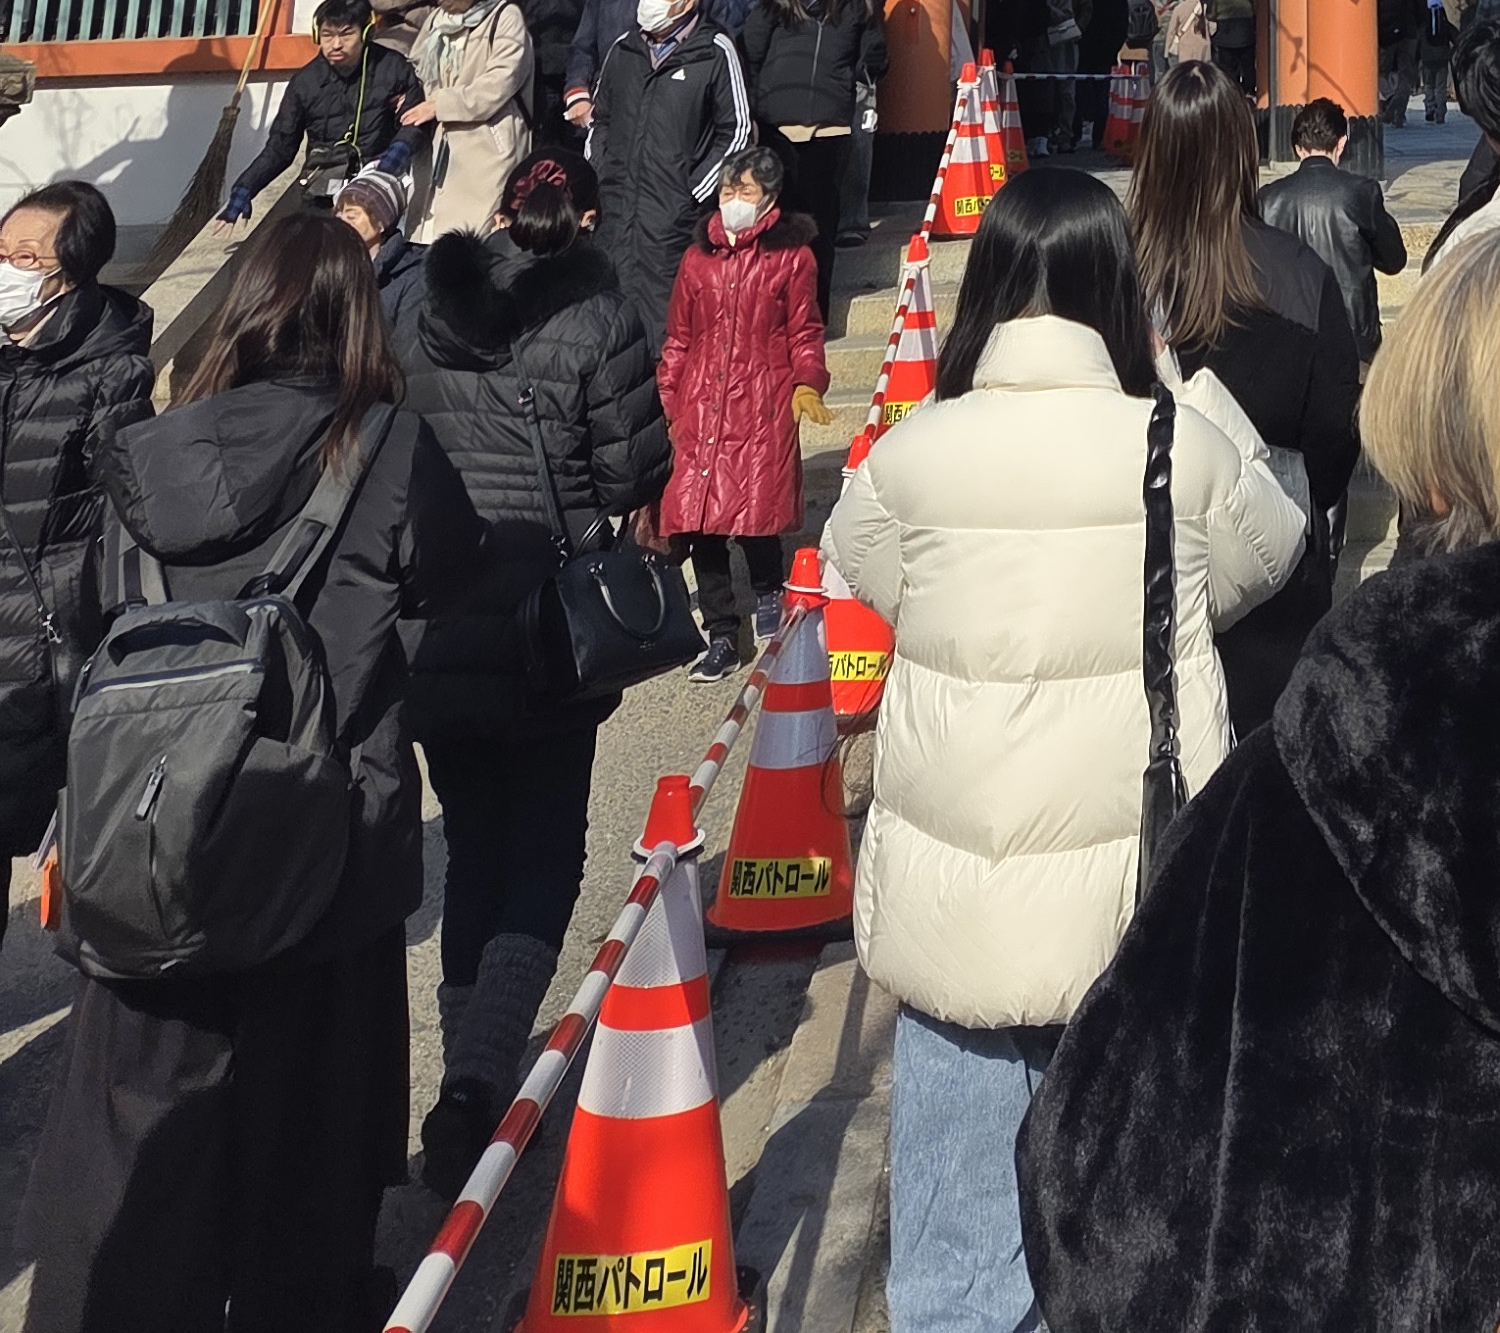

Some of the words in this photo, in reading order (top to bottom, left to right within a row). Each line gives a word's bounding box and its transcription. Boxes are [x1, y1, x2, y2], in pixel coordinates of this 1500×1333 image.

[730, 860, 829, 896] 関西パトロール
[553, 1247, 707, 1313] 関西パトロール
